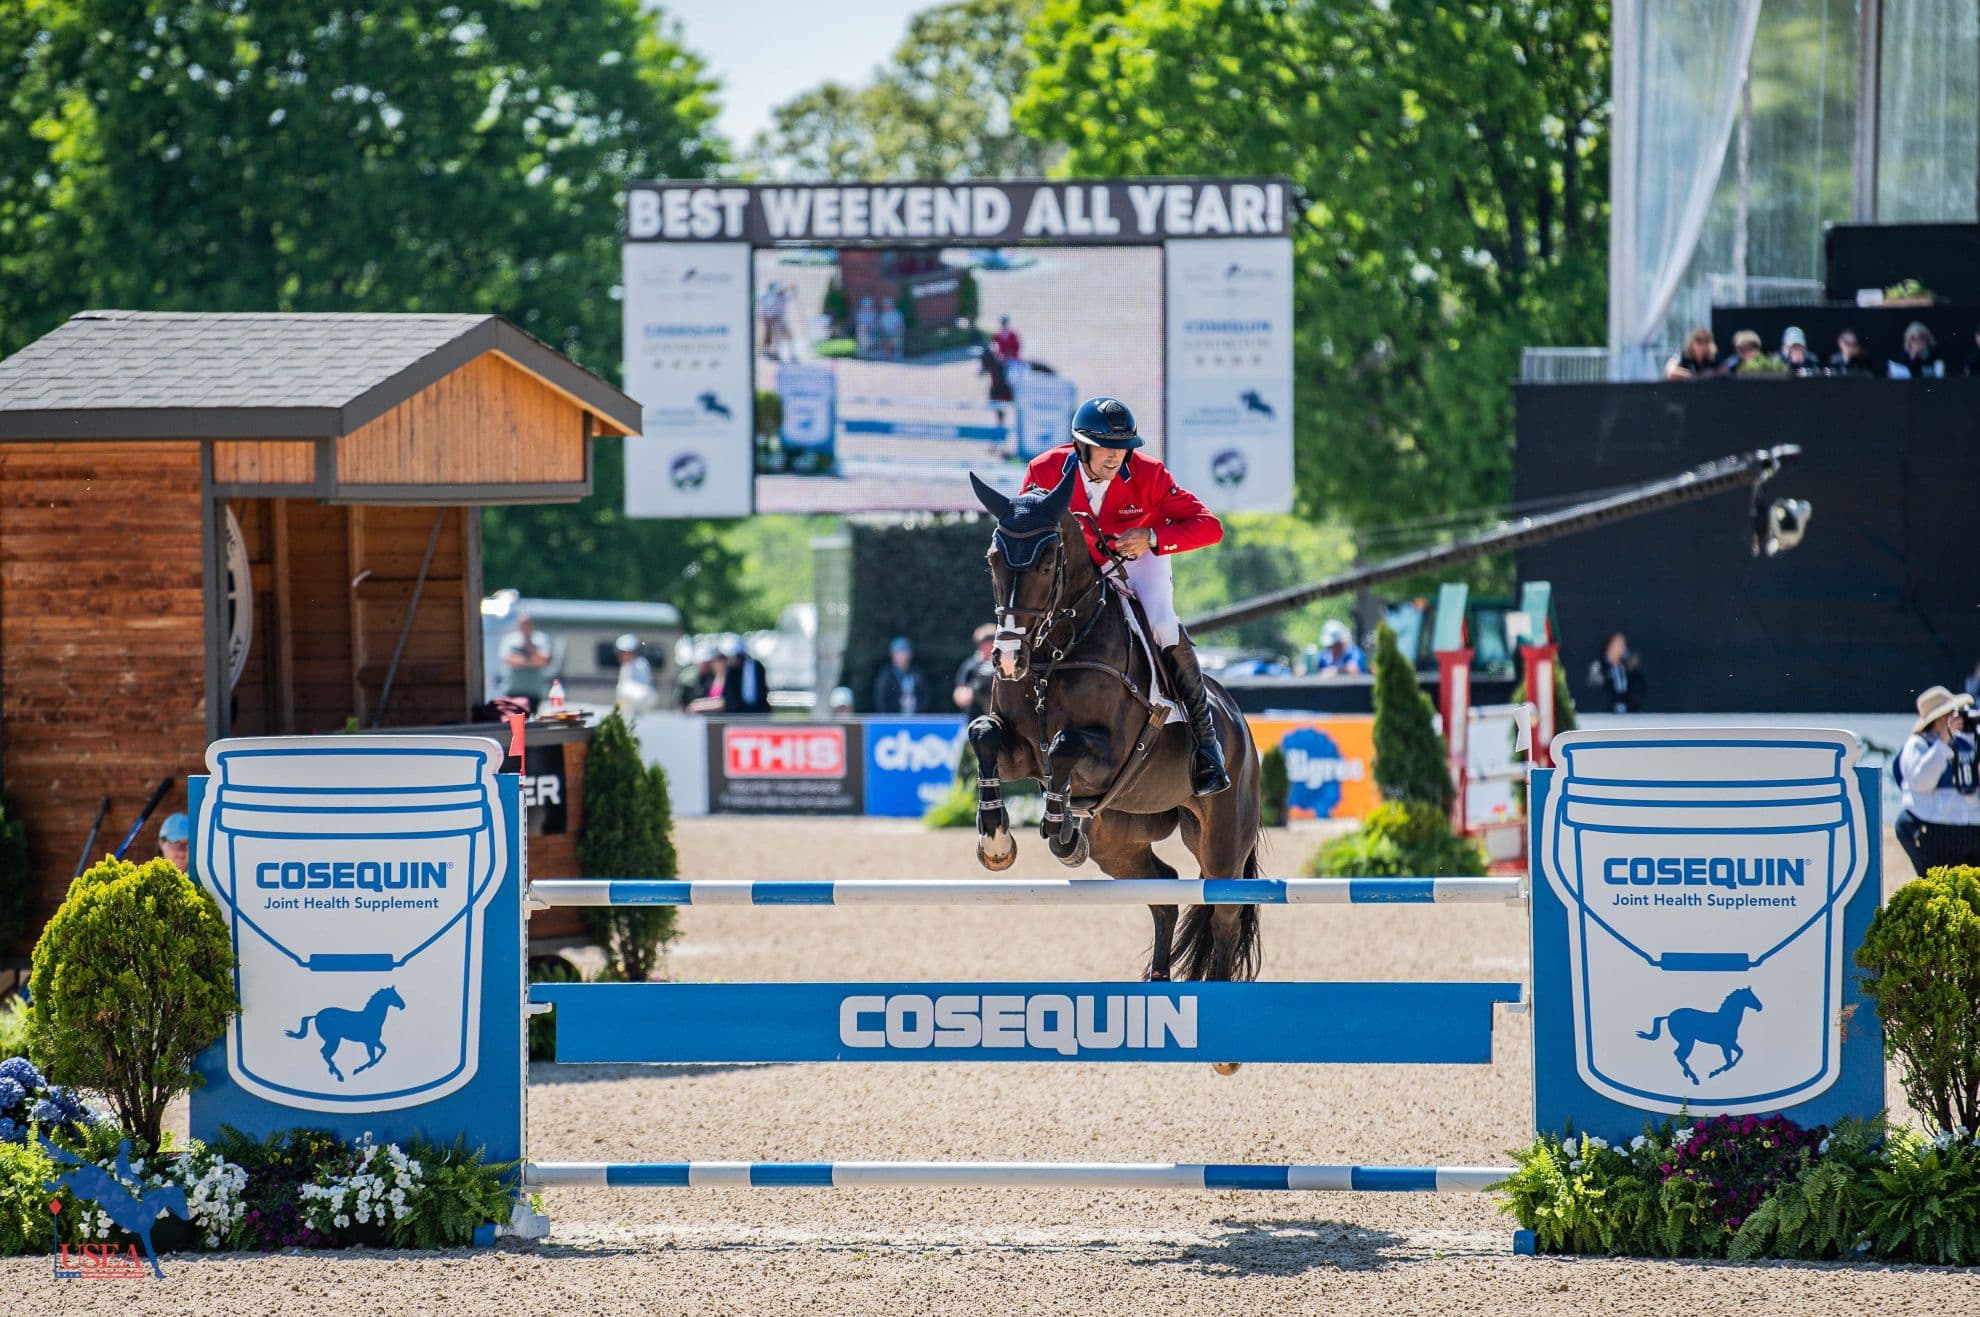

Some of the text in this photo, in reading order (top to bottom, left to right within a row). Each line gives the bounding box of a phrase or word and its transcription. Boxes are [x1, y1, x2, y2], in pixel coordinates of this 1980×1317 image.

[628, 183, 1283, 238] BEST WEEKEND ALL YEAR!
[729, 737, 838, 769] THIS
[264, 896, 439, 912] Joint Health Supplement
[1612, 893, 1797, 910] Joint Health Supplement
[839, 994, 1198, 1055] COSEQUIN
